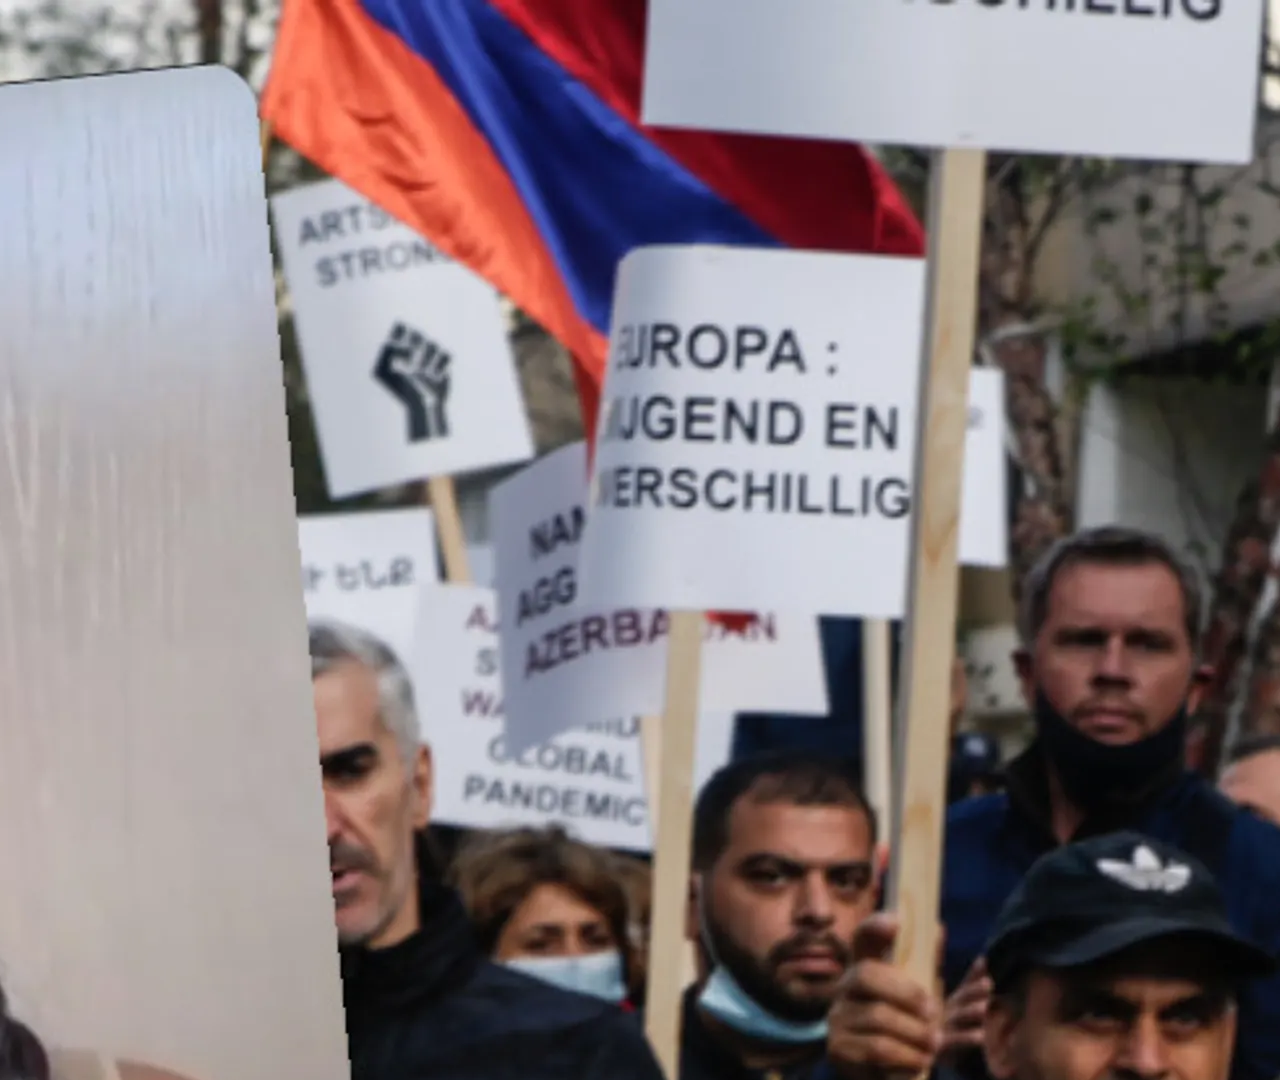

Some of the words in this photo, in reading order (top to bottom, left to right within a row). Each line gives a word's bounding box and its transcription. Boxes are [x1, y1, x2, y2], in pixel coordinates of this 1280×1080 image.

[298, 204, 402, 246] ARTS
[315, 240, 455, 289] STRON
[825, 402, 899, 450] EN
[462, 774, 646, 827] PANDEMIC
